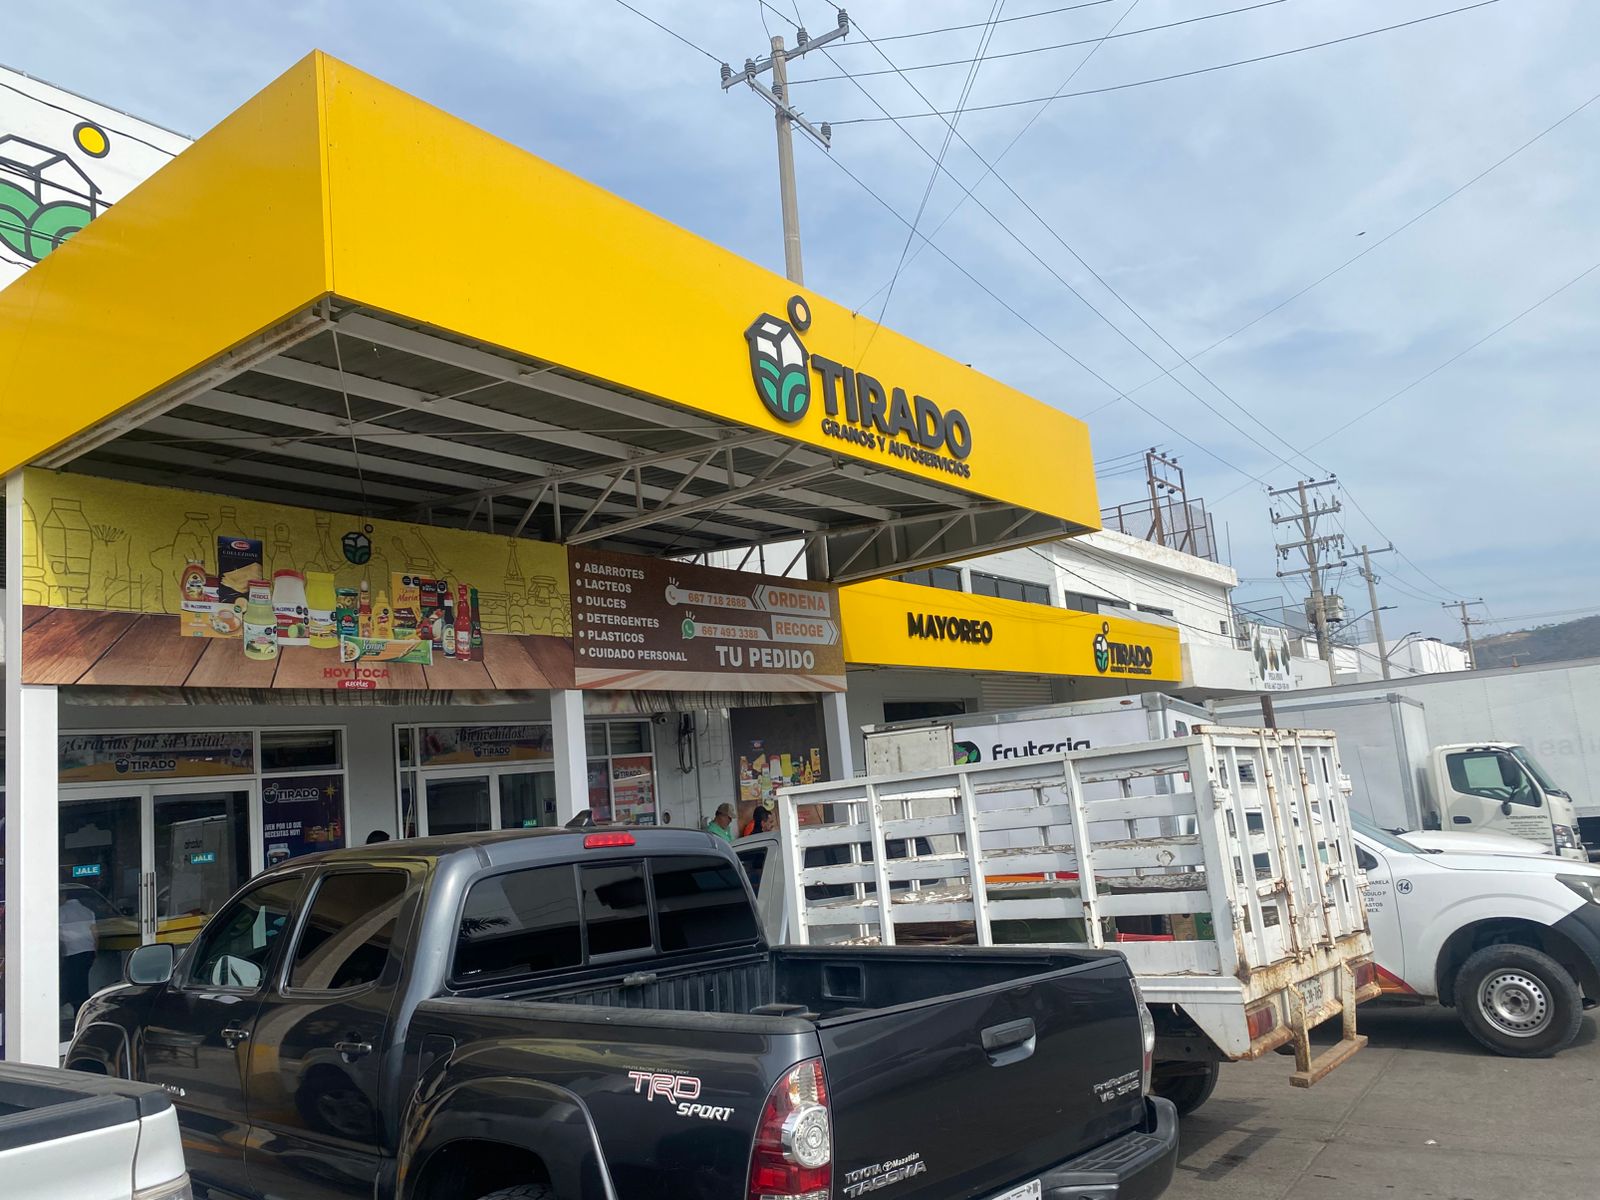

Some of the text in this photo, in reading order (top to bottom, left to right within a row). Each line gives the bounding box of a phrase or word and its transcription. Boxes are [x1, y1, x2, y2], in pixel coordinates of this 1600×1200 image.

[810, 353, 972, 460] TIRADO
[821, 418, 971, 479] GRANOS Y AUTOSERVICIOS
[583, 563, 645, 580] ABARROTES
[584, 579, 632, 594] LACTEOS
[585, 596, 627, 609] DULCES
[767, 590, 827, 612] ORDENA
[586, 612, 660, 629] DETERGENTES
[775, 620, 824, 638] RECOGE
[906, 611, 994, 645] MAYOREO
[587, 630, 645, 644] PLASTICOS
[588, 647, 688, 662] CUIDADO PERSONAL
[715, 645, 816, 670] TU PEDIDO
[1108, 642, 1153, 668] TIRADO
[323, 668, 391, 679] HOY TOCA
[133, 736, 159, 751] por
[131, 760, 176, 770] TIRADO
[278, 788, 319, 799] TIRADO
[75, 866, 99, 874] JALE
[1398, 882, 1410, 891] 14
[628, 1071, 701, 1105] TRD
[1100, 1090, 1116, 1103] V6
[676, 1102, 735, 1121] SPORT
[845, 1152, 920, 1184] TOYOTA Mazatlán
[843, 1160, 928, 1199] TACOMA
